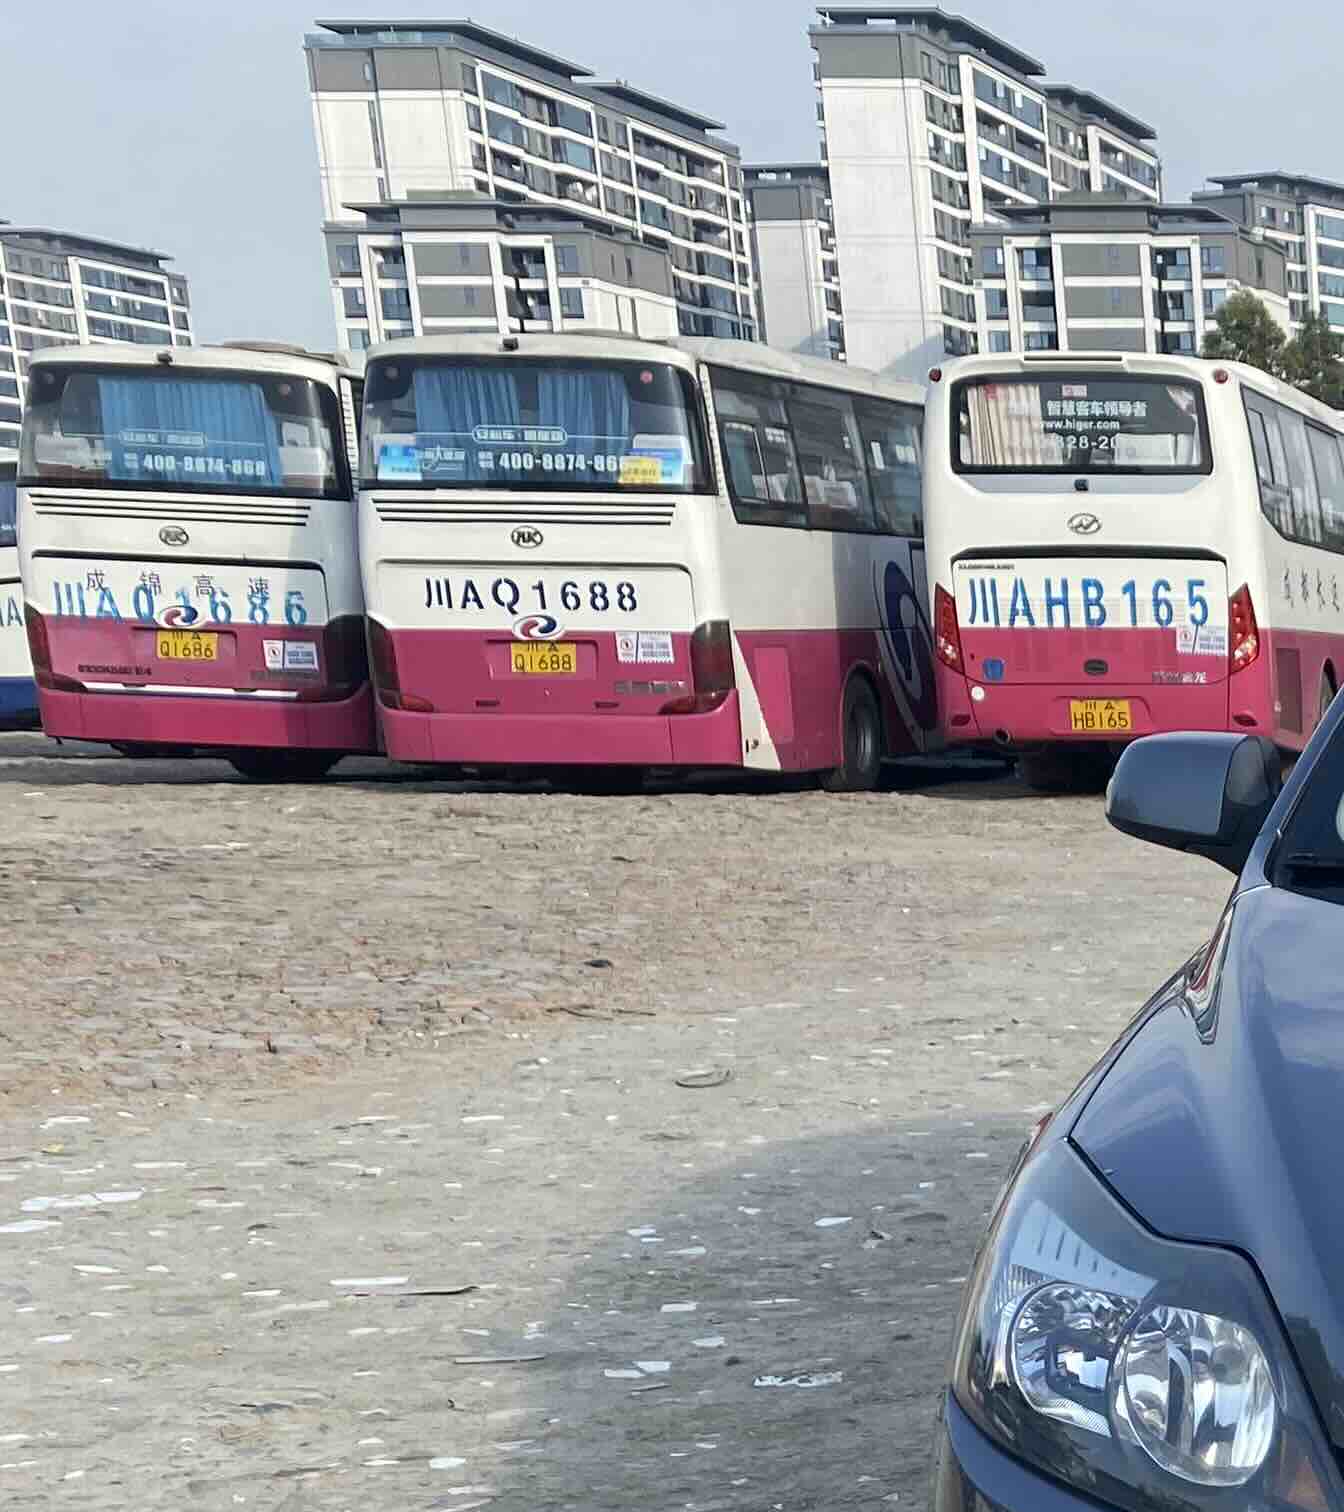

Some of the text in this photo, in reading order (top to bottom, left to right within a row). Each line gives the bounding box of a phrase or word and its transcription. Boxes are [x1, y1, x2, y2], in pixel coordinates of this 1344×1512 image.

[425, 577, 637, 615] 川AQ1688
[968, 576, 1209, 631] 川AHB165
[160, 640, 213, 658] Q1686
[514, 653, 572, 671] Q1688
[1073, 711, 1129, 729] HB165
